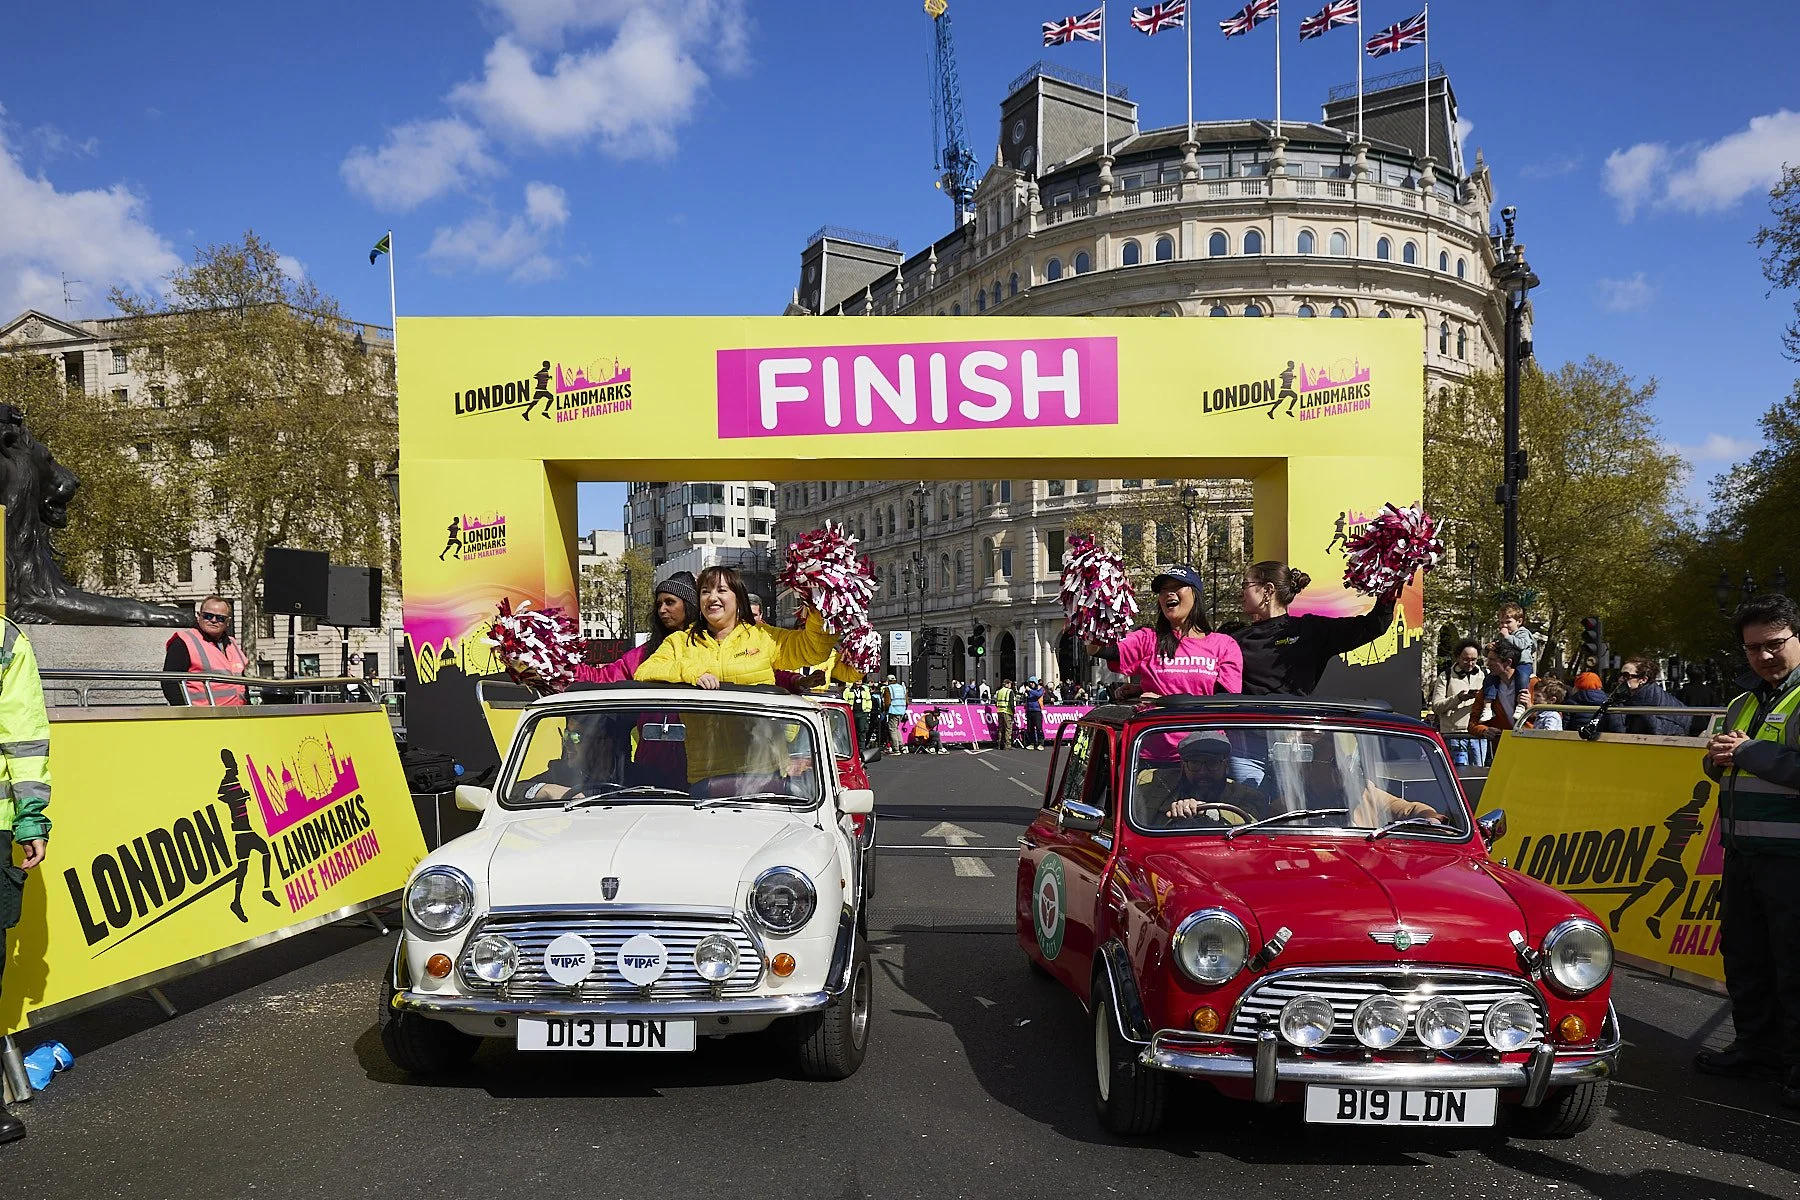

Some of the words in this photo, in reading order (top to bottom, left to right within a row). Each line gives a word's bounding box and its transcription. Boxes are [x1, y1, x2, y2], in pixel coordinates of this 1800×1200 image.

[455, 379, 530, 415] LONDON
[556, 383, 632, 410] LANDMARKS
[758, 348, 1081, 430] FINISH
[1203, 379, 1275, 413] LONDON
[1300, 383, 1371, 409] LANDMARKS
[556, 410, 579, 423] HALF
[582, 399, 632, 418] MARATHON
[1300, 409, 1321, 422] HALF
[1324, 399, 1371, 417] MARATHON
[463, 525, 506, 544] LONDON
[463, 538, 506, 554] LANDMARKS
[463, 553, 477, 561] HALF
[478, 547, 507, 559] MARATHON
[272, 794, 370, 880] LANDMARKS
[64, 803, 233, 946] LONDON
[285, 866, 320, 913] HALF
[320, 829, 381, 894] MARATHON
[550, 956, 586, 968] WIPAC
[624, 957, 660, 968] WIPAC
[546, 1019, 595, 1047] D13
[605, 1019, 666, 1047] LDN
[1336, 1088, 1390, 1121] B19
[1400, 1090, 1467, 1122] LDN
